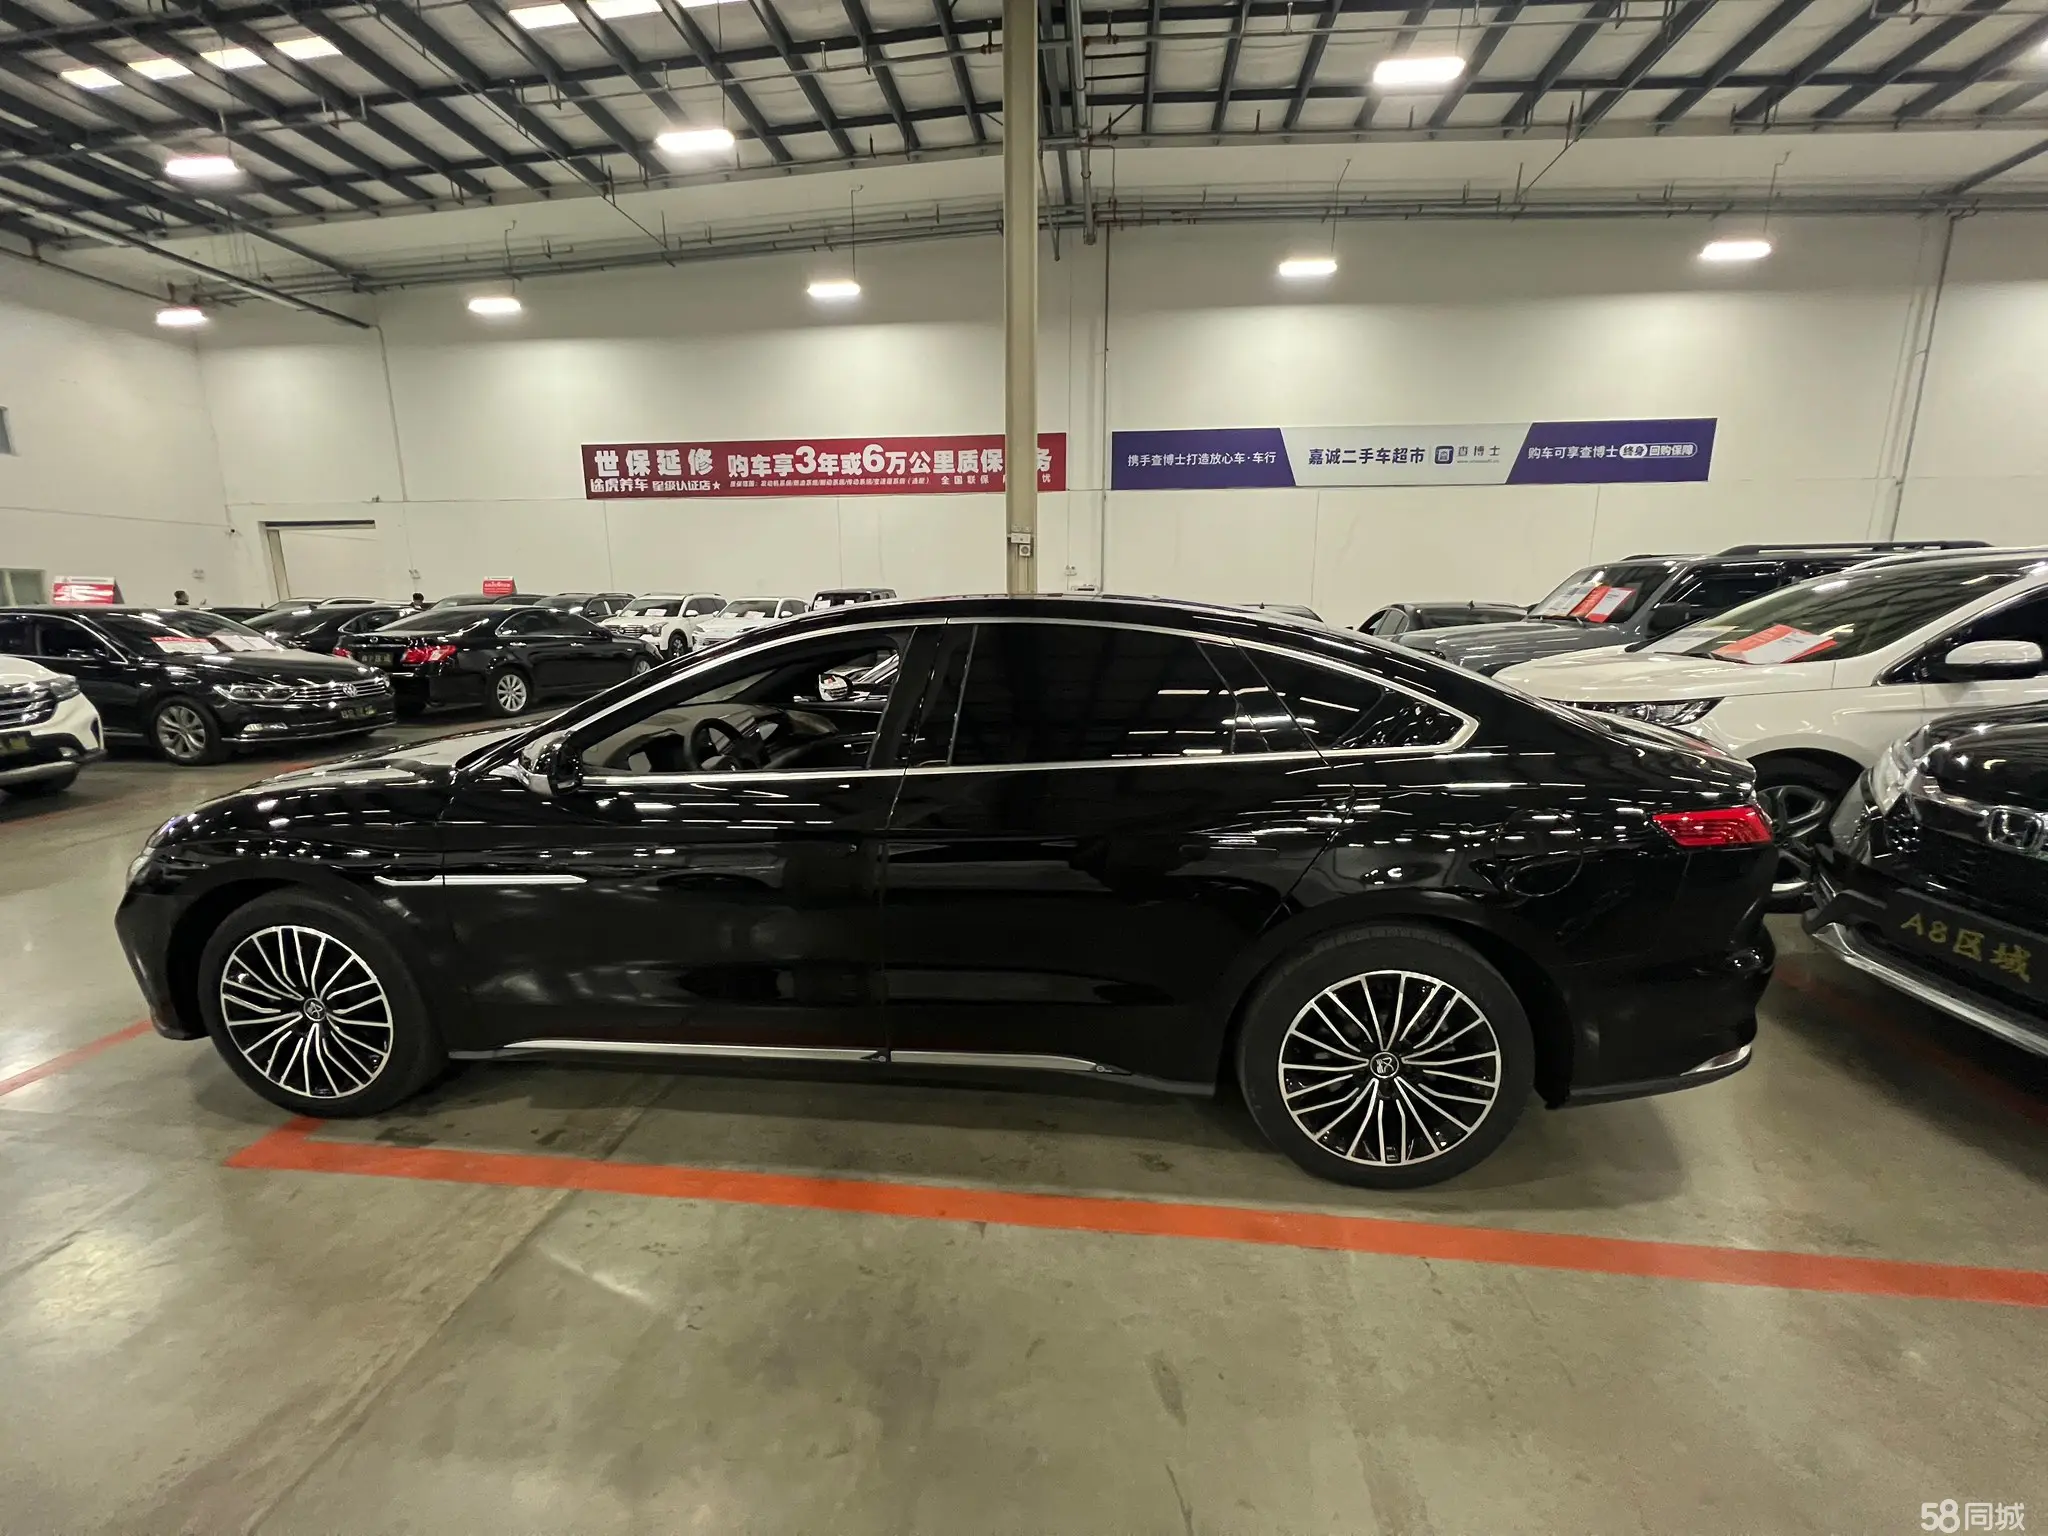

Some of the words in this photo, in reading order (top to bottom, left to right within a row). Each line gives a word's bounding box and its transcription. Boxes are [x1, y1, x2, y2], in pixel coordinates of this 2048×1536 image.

[594, 448, 714, 477] 世保延修
[727, 444, 1052, 478] 购车享3年或6万公里质保务
[1308, 447, 1426, 465] 嘉诚二手车超市
[590, 478, 649, 493] 途虎养车
[940, 474, 990, 485] 全国联保
[1901, 913, 2032, 983] A8区域
